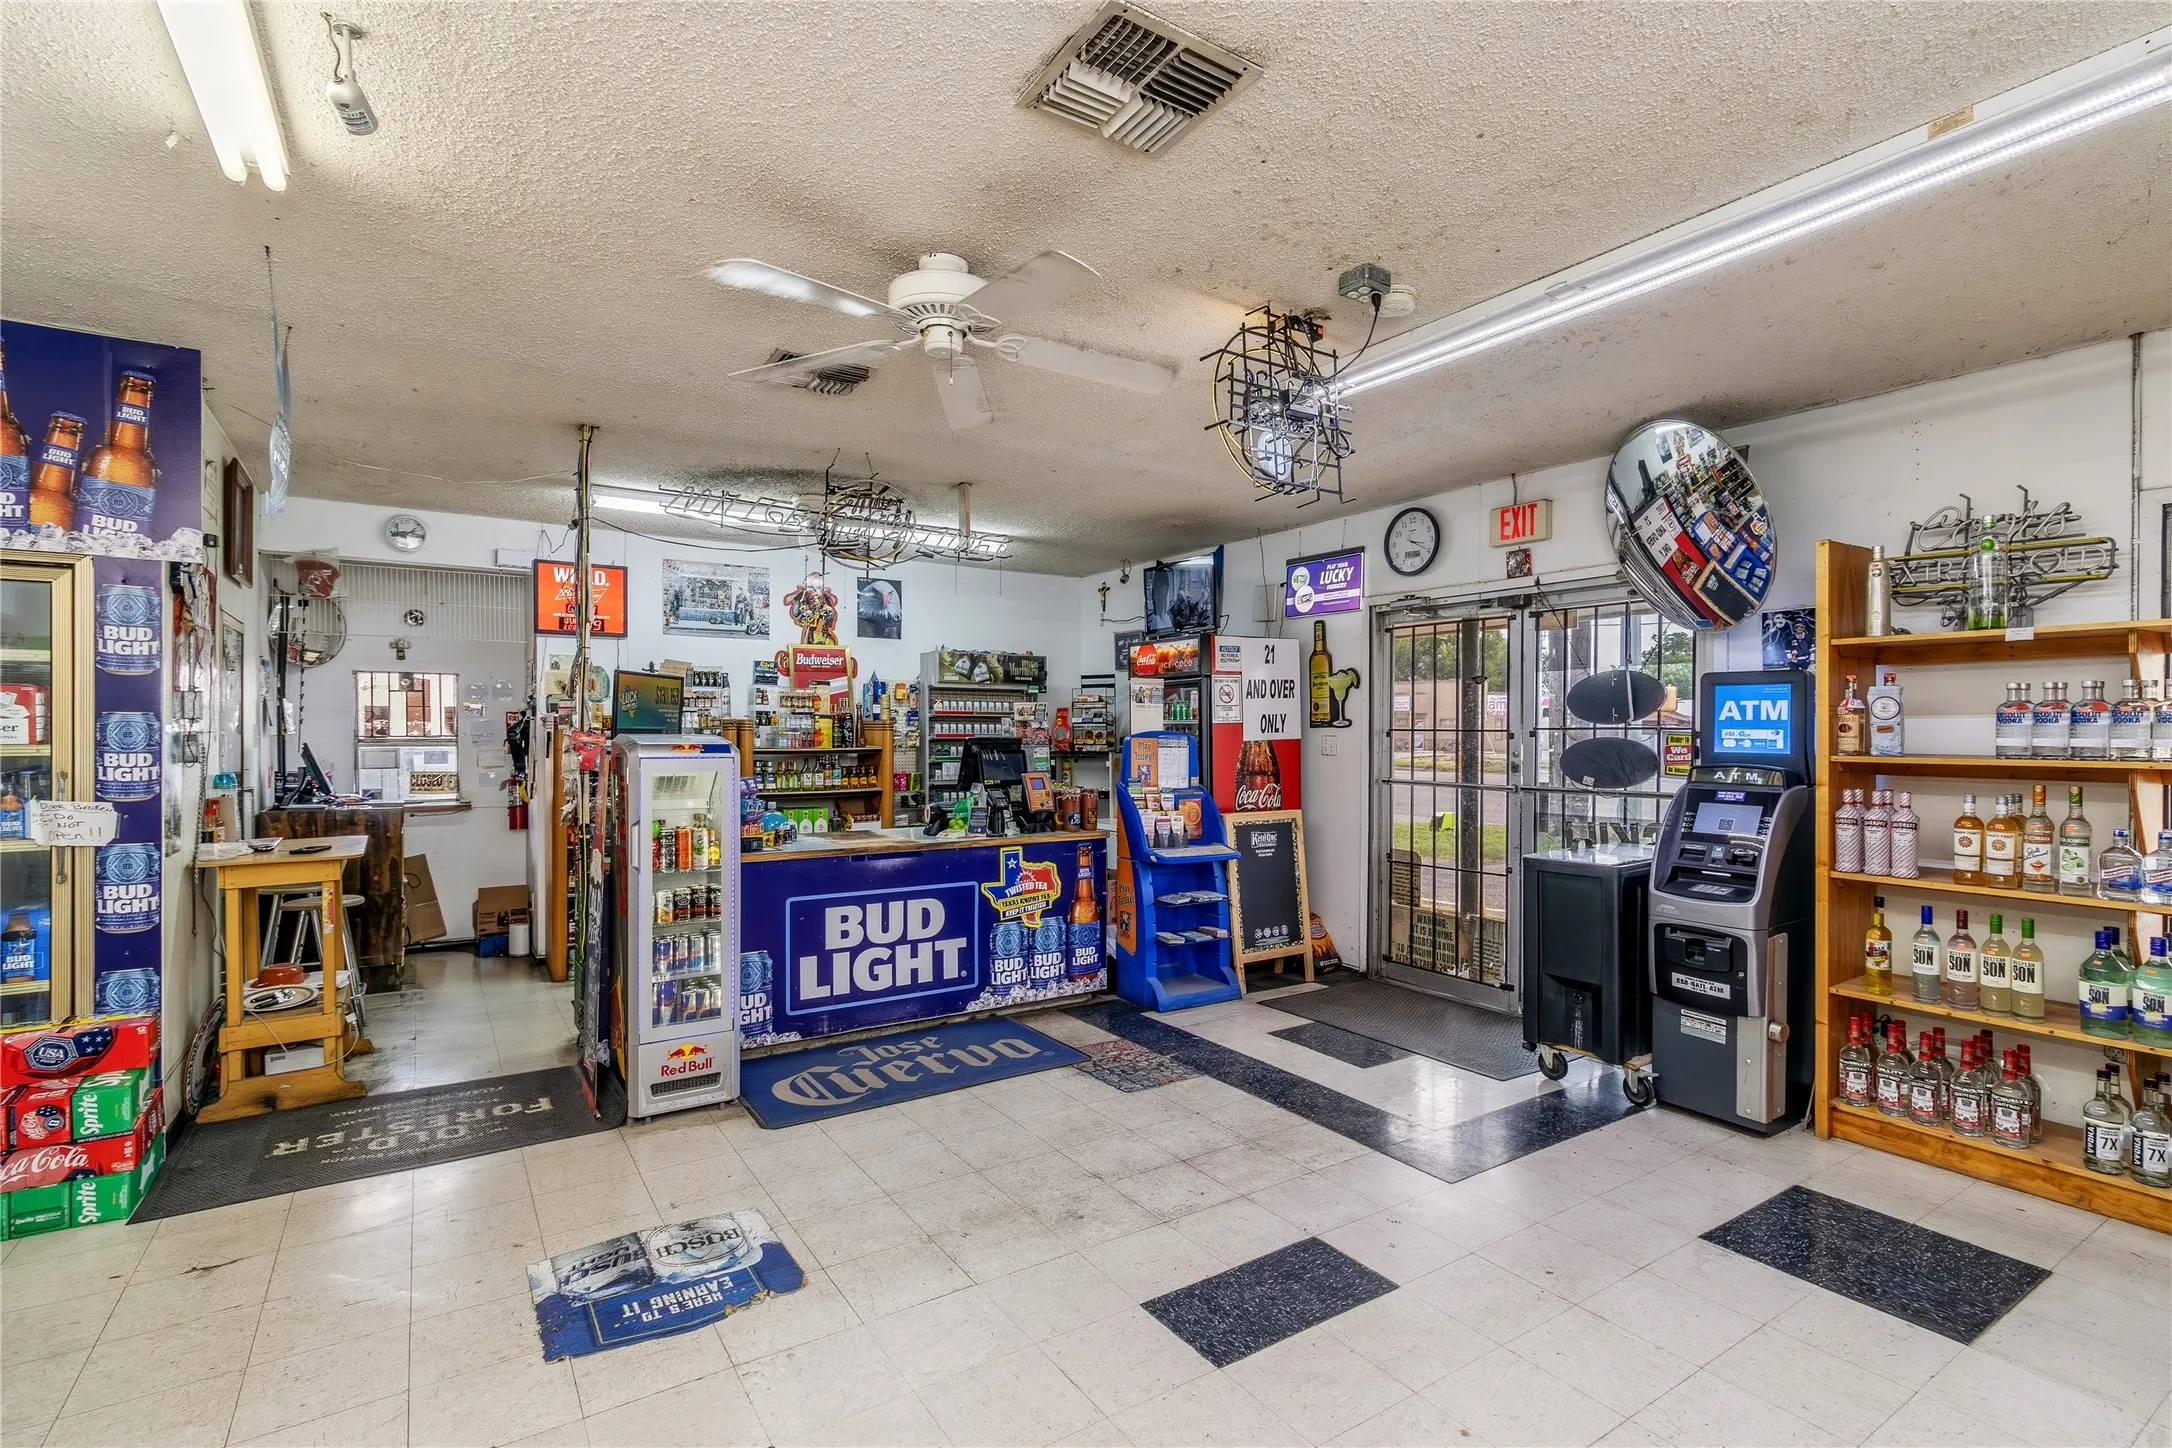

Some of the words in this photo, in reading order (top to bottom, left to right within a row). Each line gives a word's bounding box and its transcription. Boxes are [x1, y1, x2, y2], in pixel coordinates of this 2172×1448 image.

[117, 411, 147, 423] LIGHT
[121, 406, 144, 416] BUD
[42, 453, 75, 465] LIGHT
[49, 448, 72, 459] BUD
[92, 514, 138, 533] BUD
[1500, 503, 1537, 541] EXIT
[1320, 566, 1354, 585] LUCKY
[103, 626, 153, 641] BUD
[98, 640, 160, 657] LIGHT
[1264, 645, 1275, 664] 21
[796, 653, 844, 666] Budweiser
[1174, 659, 1193, 668] COLD
[1245, 679, 1267, 700] AND
[1270, 679, 1295, 699] OVER
[1718, 699, 1789, 721] ATM
[1260, 713, 1287, 734] ONLY
[104, 753, 153, 768] BUD
[1666, 753, 1692, 761] Card
[97, 766, 160, 782] LIGHT
[1236, 783, 1282, 811] Coca-Cola
[103, 884, 153, 899] BUD
[1005, 883, 1034, 898] TWISTED
[1035, 881, 1048, 891] TEA
[97, 897, 160, 914] LIGHT
[825, 897, 945, 950] BUD
[5, 954, 27, 963] BUD
[1034, 952, 1062, 966] BUD
[1075, 946, 1096, 956] BUD
[1913, 949, 1934, 965] SON
[2, 960, 35, 970] LIGHT
[994, 957, 1024, 972] BUD
[1072, 954, 1098, 966] LIGHT
[1949, 955, 1971, 972] SON
[799, 937, 967, 1001] LIGHT
[991, 969, 1028, 985] LIGHT
[1030, 962, 1066, 979] LIGHT
[1983, 960, 2006, 978] SON
[2013, 965, 2035, 983] SON
[741, 993, 767, 1009] UD
[2089, 989, 2110, 1004] SON
[2142, 996, 2165, 1013] SON
[740, 1006, 772, 1024] GHT
[38, 1047, 64, 1059] USA
[661, 1061, 686, 1076] Red
[688, 1057, 713, 1072] Bull
[771, 1037, 1043, 1107] Cuervo
[80, 1094, 103, 1136] Sprite
[367, 1124, 469, 1151] OLD
[2087, 1126, 2095, 1154] VODKA
[2100, 1137, 2118, 1151] 7X
[2133, 1137, 2142, 1165] VODKA
[2147, 1148, 2166, 1163] 7X
[76, 1181, 101, 1224] Sprite
[655, 1227, 741, 1259] BUSCH
[651, 1276, 734, 1310] EARNING
[622, 1301, 641, 1318] IT
[670, 1292, 723, 1316] HERE'S
[642, 1308, 662, 1323] TO
